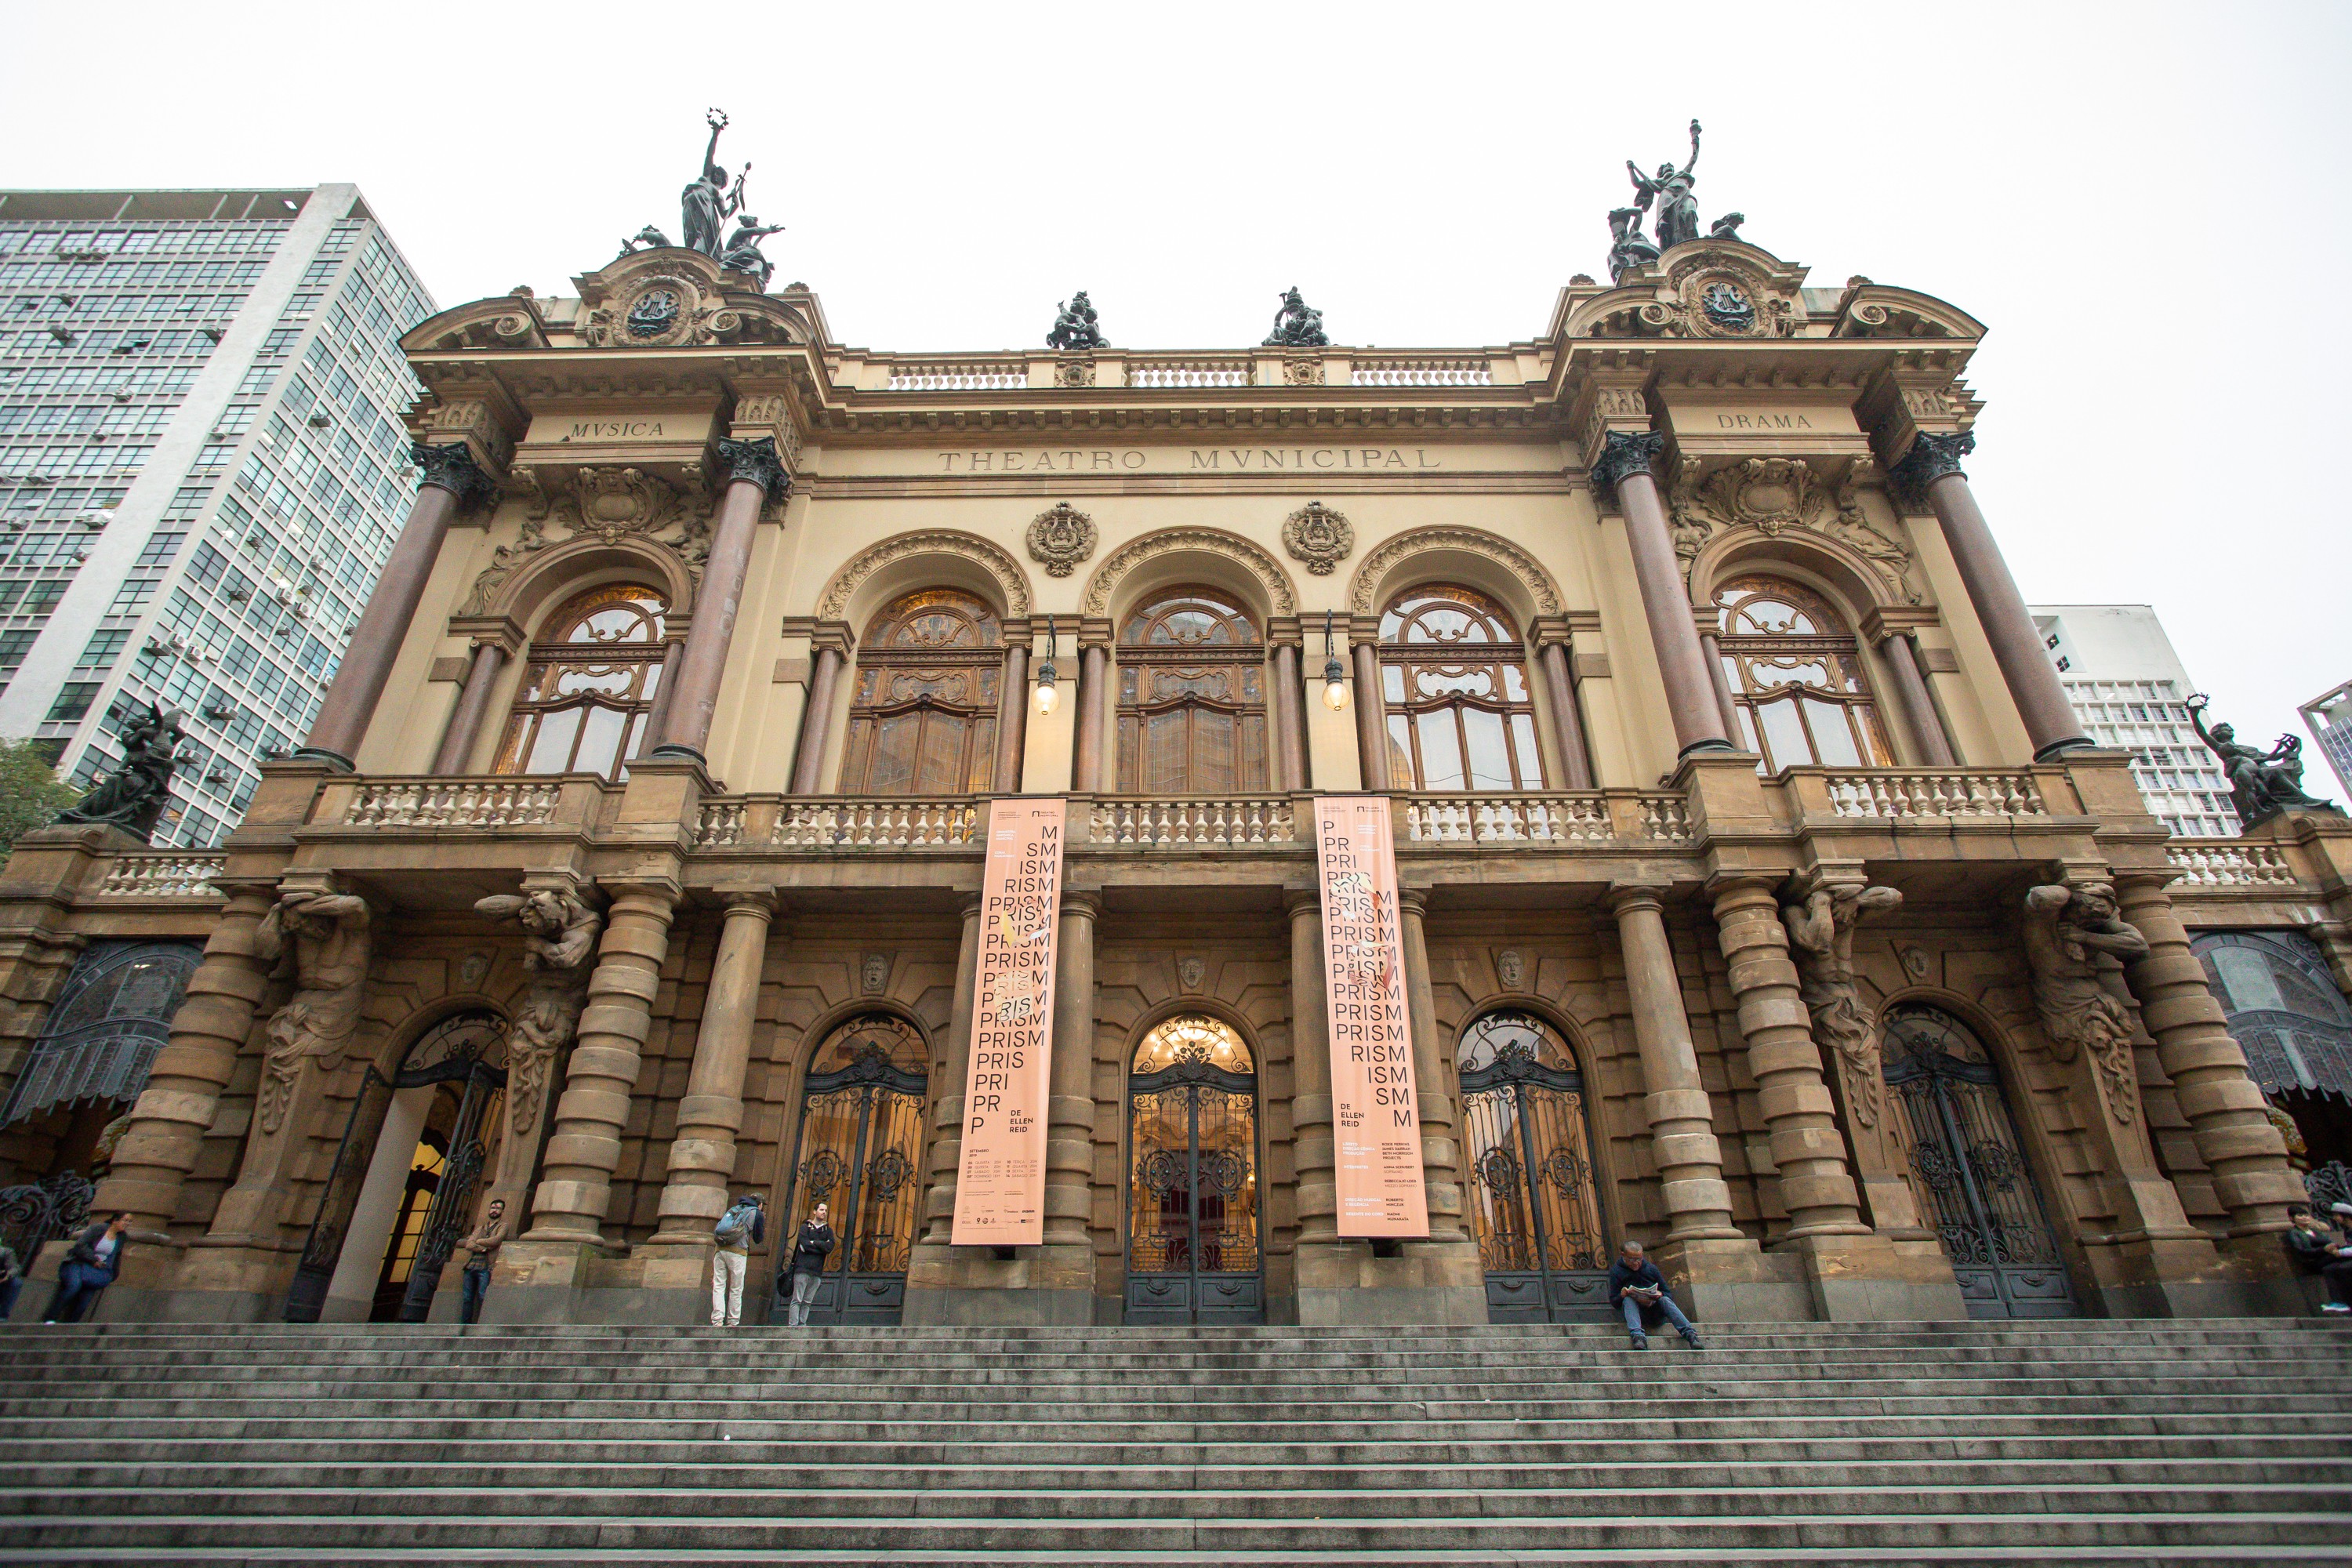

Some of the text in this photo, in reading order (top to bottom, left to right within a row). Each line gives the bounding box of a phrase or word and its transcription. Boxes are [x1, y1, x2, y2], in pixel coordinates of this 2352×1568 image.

[571, 423, 663, 437] MVSICA
[1717, 415, 1812, 428] DRAMA
[938, 449, 1441, 471] THEATRO MVNICIPAL
[1042, 826, 1057, 839] M
[1323, 821, 1334, 833] P
[1026, 843, 1056, 857] SM
[1324, 837, 1348, 851] PR
[1020, 860, 1054, 874] ISM
[1326, 854, 1356, 868] PRI
[1005, 878, 1054, 893] RISM
[986, 932, 1051, 949] PRSM
[1330, 926, 1395, 942] PRISM
[985, 951, 1049, 968] PRISM
[1334, 983, 1400, 1000] PRISM
[1335, 1004, 1402, 1021] PRISM
[978, 1030, 1044, 1048] PRISM
[1337, 1024, 1403, 1041] PRISM
[977, 1051, 1024, 1069] PRIS
[1352, 1046, 1406, 1062] RISM
[975, 1073, 1007, 1091] PRI
[1368, 1066, 1407, 1083] ISM
[973, 1095, 1000, 1112] PR
[1376, 1088, 1410, 1105] SM
[971, 1117, 984, 1134] P
[1394, 1110, 1411, 1127] M
